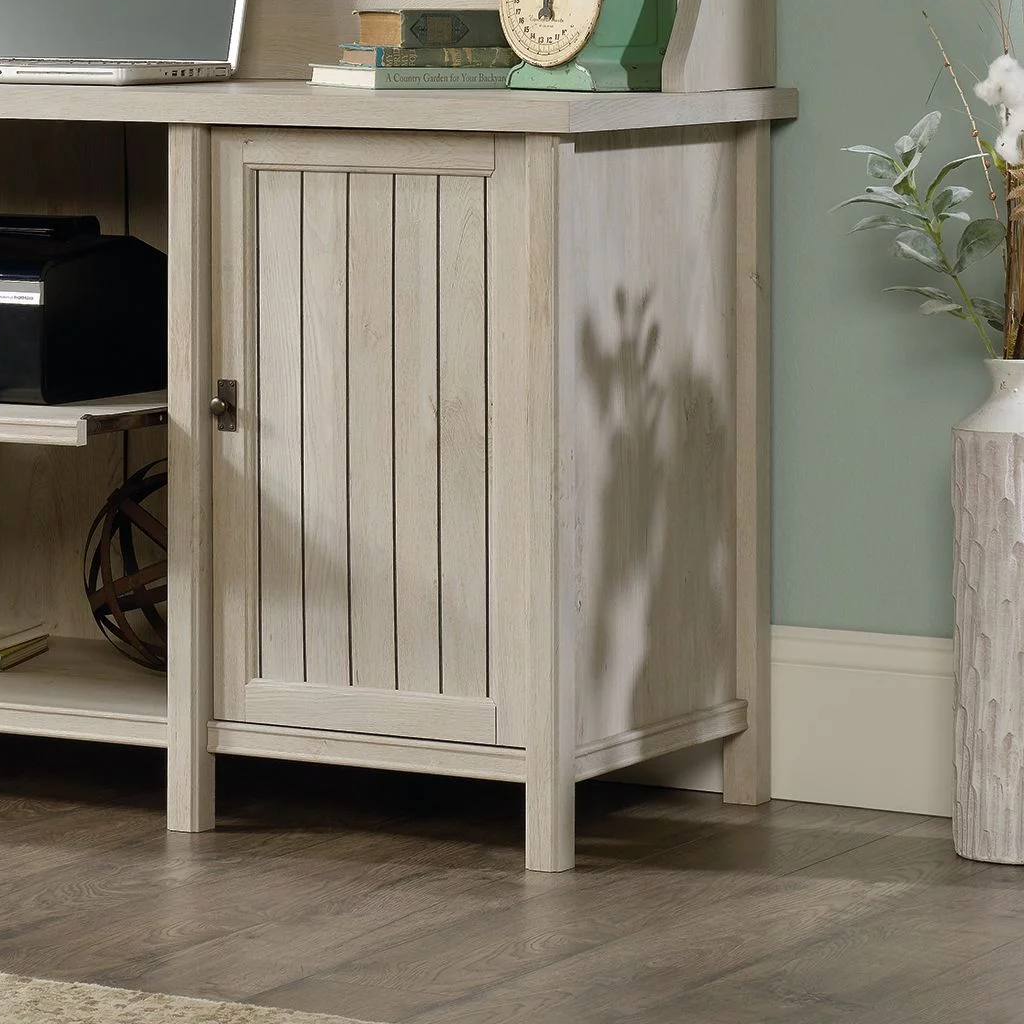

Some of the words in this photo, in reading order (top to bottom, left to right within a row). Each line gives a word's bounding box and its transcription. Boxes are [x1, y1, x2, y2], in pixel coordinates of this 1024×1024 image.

[386, 73, 392, 82] A
[393, 72, 421, 85] Country
[423, 72, 449, 82] Garden
[450, 72, 459, 82] for
[461, 72, 476, 82] Your
